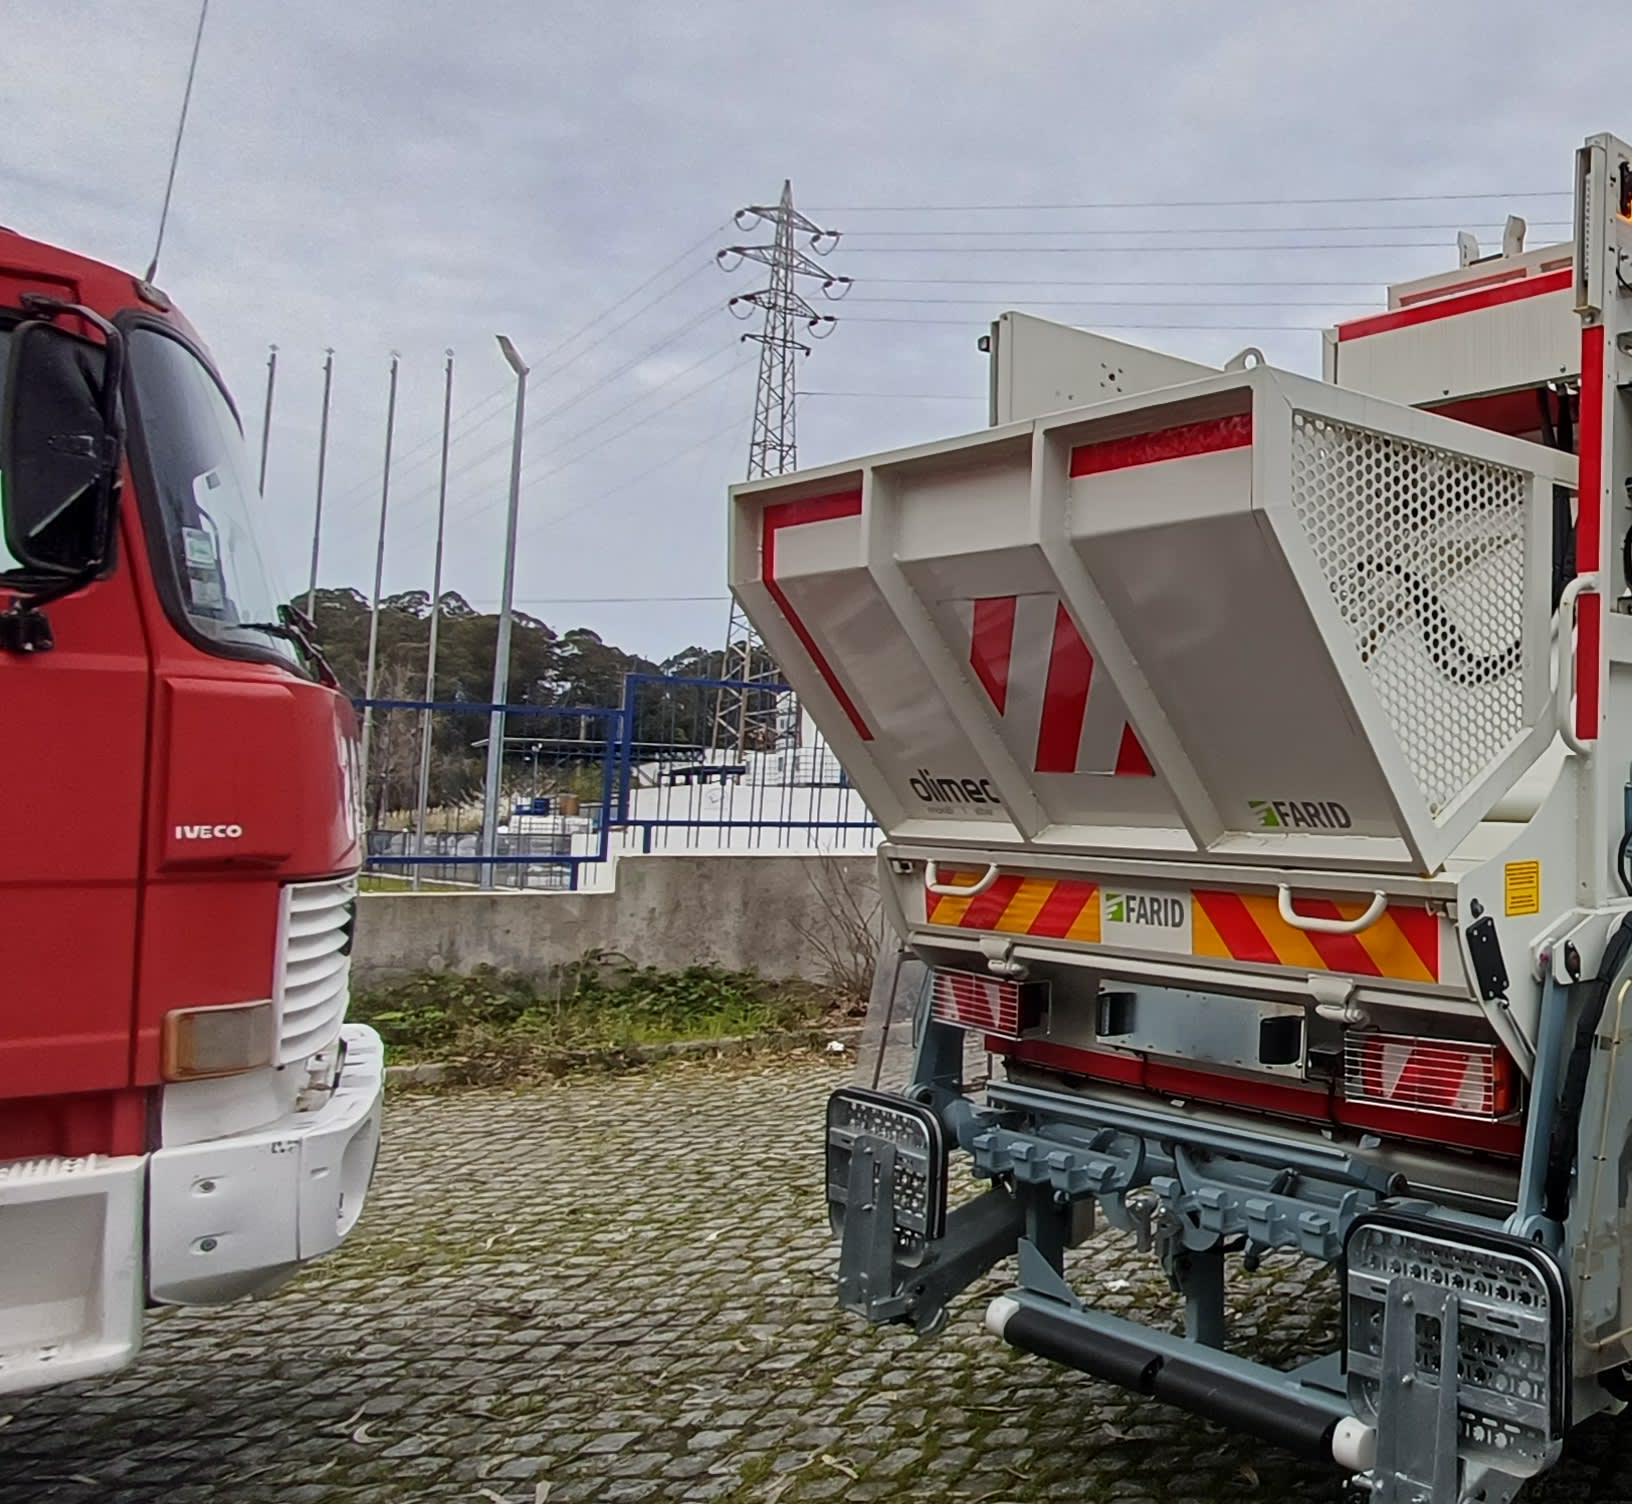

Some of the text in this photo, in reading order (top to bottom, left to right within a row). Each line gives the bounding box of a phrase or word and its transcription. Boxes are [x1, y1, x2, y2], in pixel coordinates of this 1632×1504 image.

[910, 768, 1001, 804] olimec
[1272, 801, 1352, 829] FARID
[175, 824, 243, 840] IVECO
[1125, 894, 1185, 929] FARID
